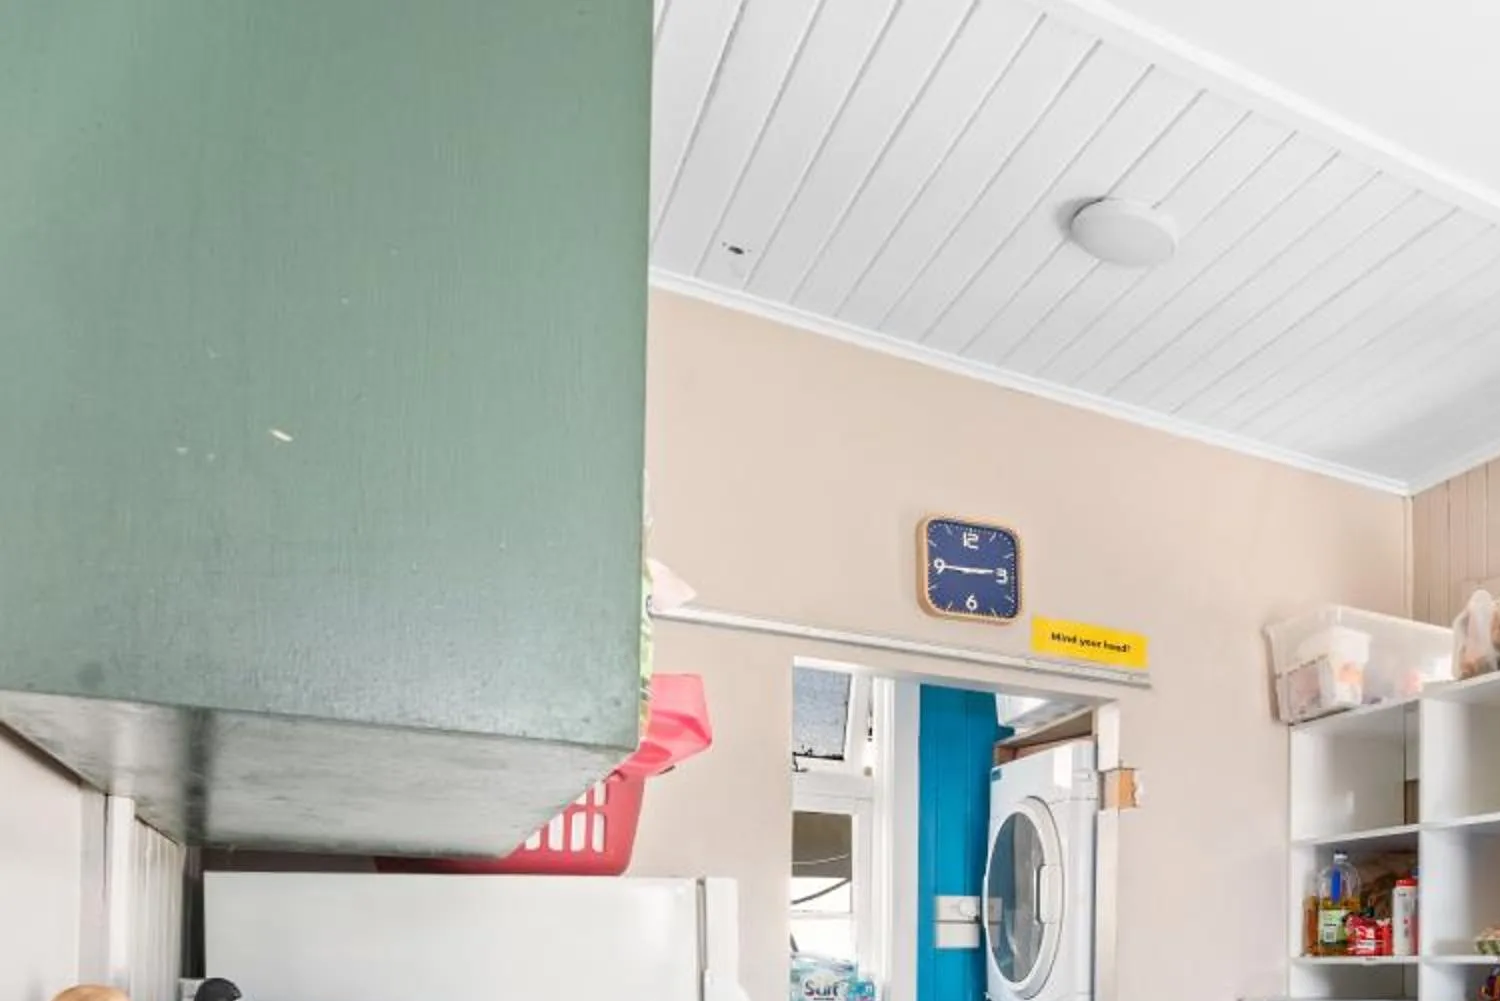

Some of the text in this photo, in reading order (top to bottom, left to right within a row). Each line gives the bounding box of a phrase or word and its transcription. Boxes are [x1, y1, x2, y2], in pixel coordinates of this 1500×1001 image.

[963, 531, 979, 550] 12
[934, 558, 1008, 584] 9 3
[965, 594, 978, 611] 6
[1051, 631, 1131, 653] Mind your head!
[804, 979, 840, 997] Surf
